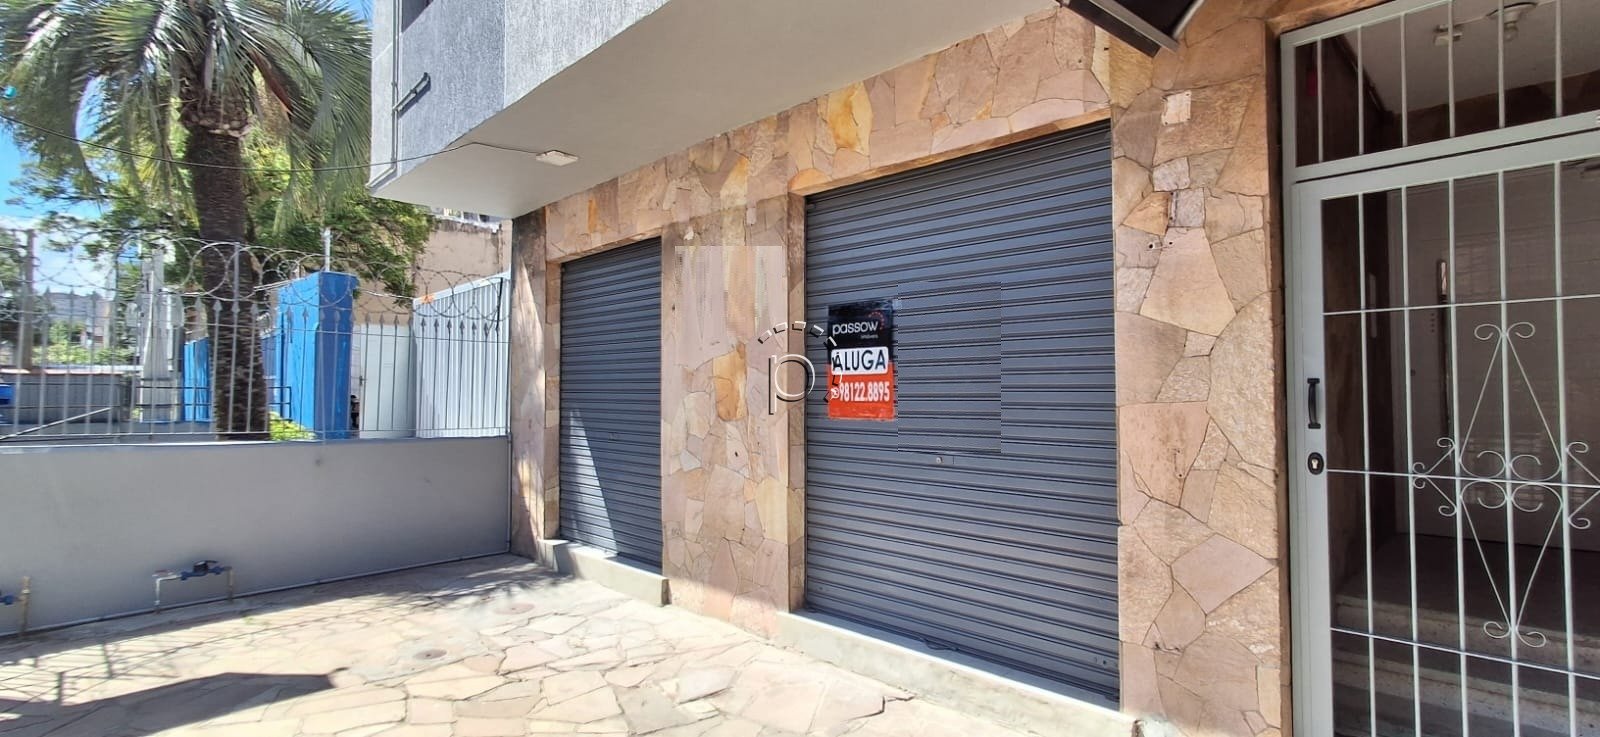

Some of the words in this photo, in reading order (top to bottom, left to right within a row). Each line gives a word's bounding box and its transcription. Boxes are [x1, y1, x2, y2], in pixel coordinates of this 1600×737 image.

[832, 321, 879, 337] passow
[832, 350, 886, 372] ALUGA
[839, 381, 890, 402] 98122.8895
